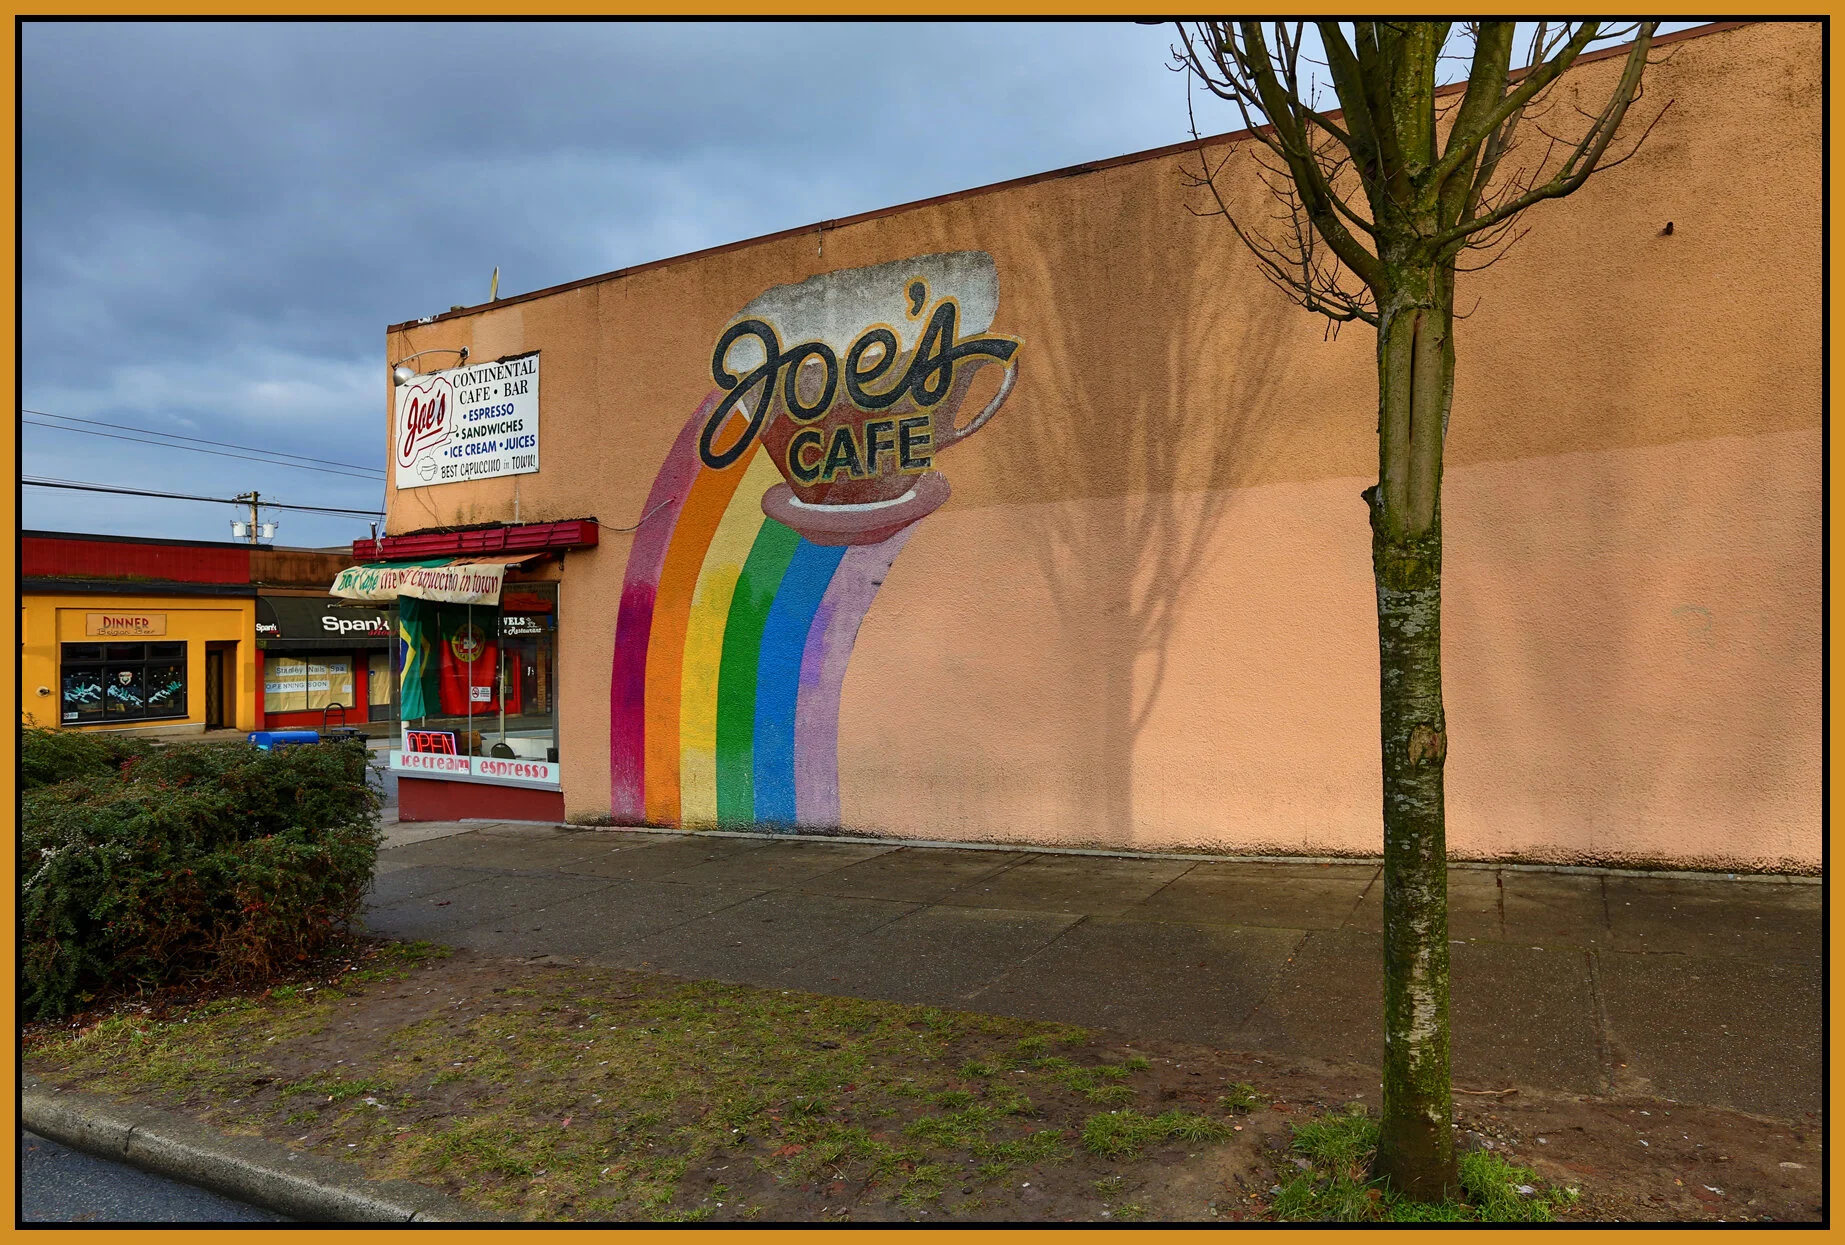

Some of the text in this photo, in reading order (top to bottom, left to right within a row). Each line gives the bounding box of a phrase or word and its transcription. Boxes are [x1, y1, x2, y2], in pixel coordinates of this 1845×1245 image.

[452, 360, 536, 388] CONTINENTAL
[697, 278, 1022, 471] Joe's
[459, 380, 528, 404] CAFE BAR
[404, 389, 446, 457] Joe's
[468, 403, 514, 421] ESPRESSO
[461, 419, 524, 440] SANDWICHES
[450, 435, 535, 458] ICE CREAM JUICES
[787, 414, 934, 485] CAFE
[441, 464, 458, 479] BEST
[460, 459, 501, 477] CAPUCCINO
[512, 454, 536, 470] TOWN!
[472, 570, 499, 594] town
[103, 616, 149, 628] DINNER
[256, 623, 277, 633] Spank
[322, 616, 390, 634] Spank
[407, 732, 455, 755] OPEN
[422, 755, 470, 771] cream
[480, 759, 549, 779] espresso
